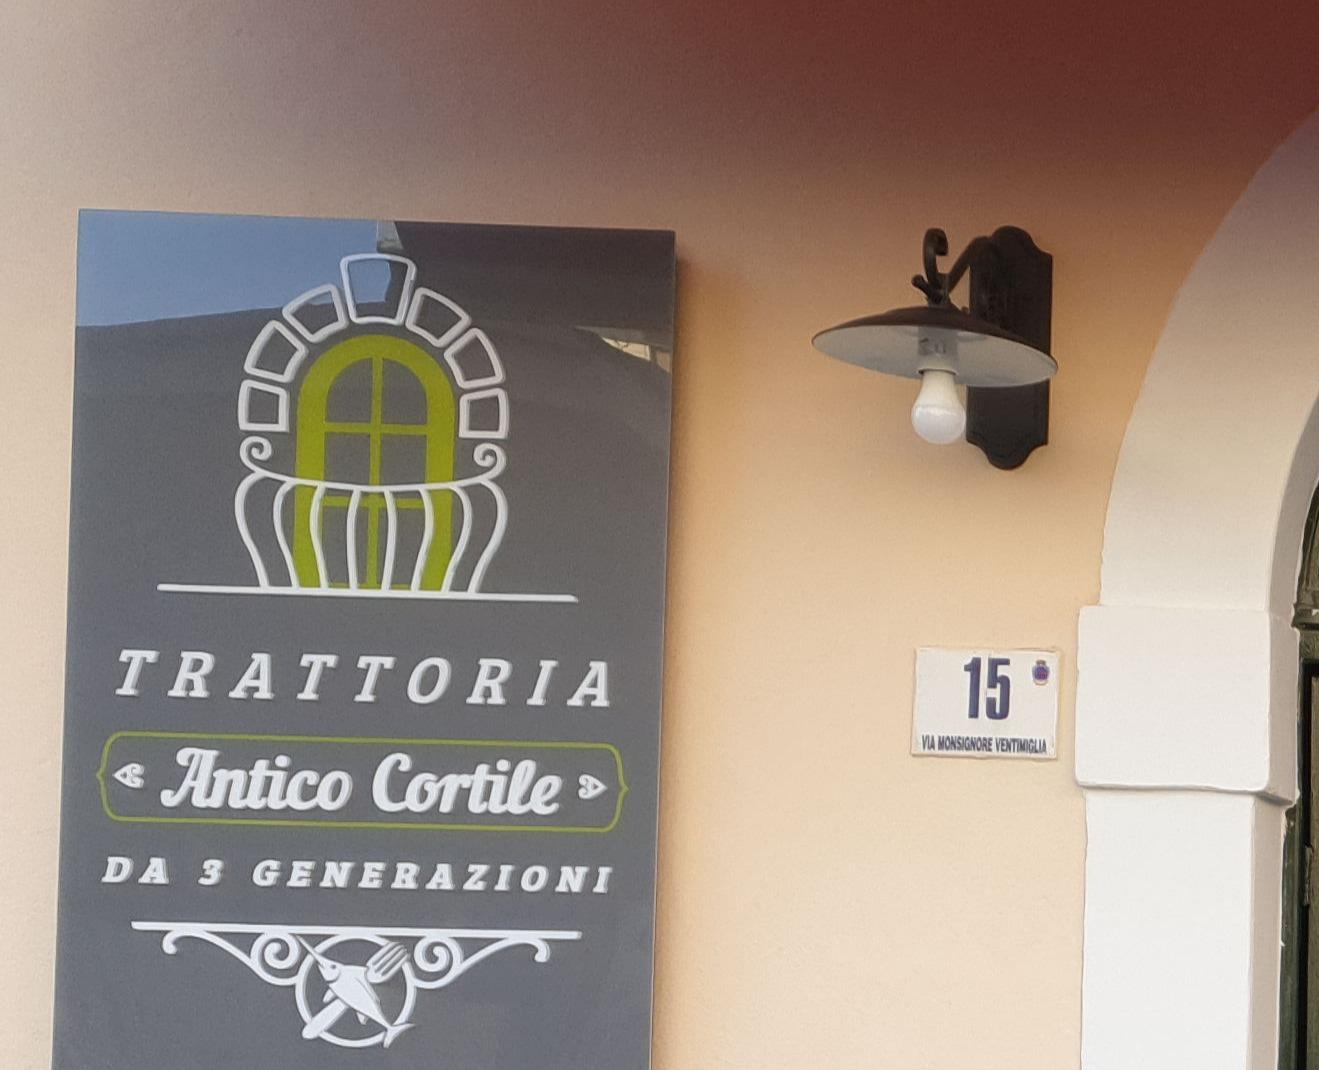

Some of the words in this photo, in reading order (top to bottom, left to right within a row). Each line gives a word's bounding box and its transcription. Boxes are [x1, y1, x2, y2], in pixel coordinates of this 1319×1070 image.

[115, 649, 612, 708] TRATTORIA
[963, 656, 1011, 721] 15
[921, 734, 936, 751] VIA
[937, 735, 993, 753] MONSIGNORE
[995, 737, 1048, 755] VENTIMIGLIA
[160, 746, 354, 813] Antico
[372, 752, 563, 816] Cortile
[101, 856, 170, 885] DA
[198, 857, 225, 886] 3
[252, 860, 613, 894] GENERAZIONI
